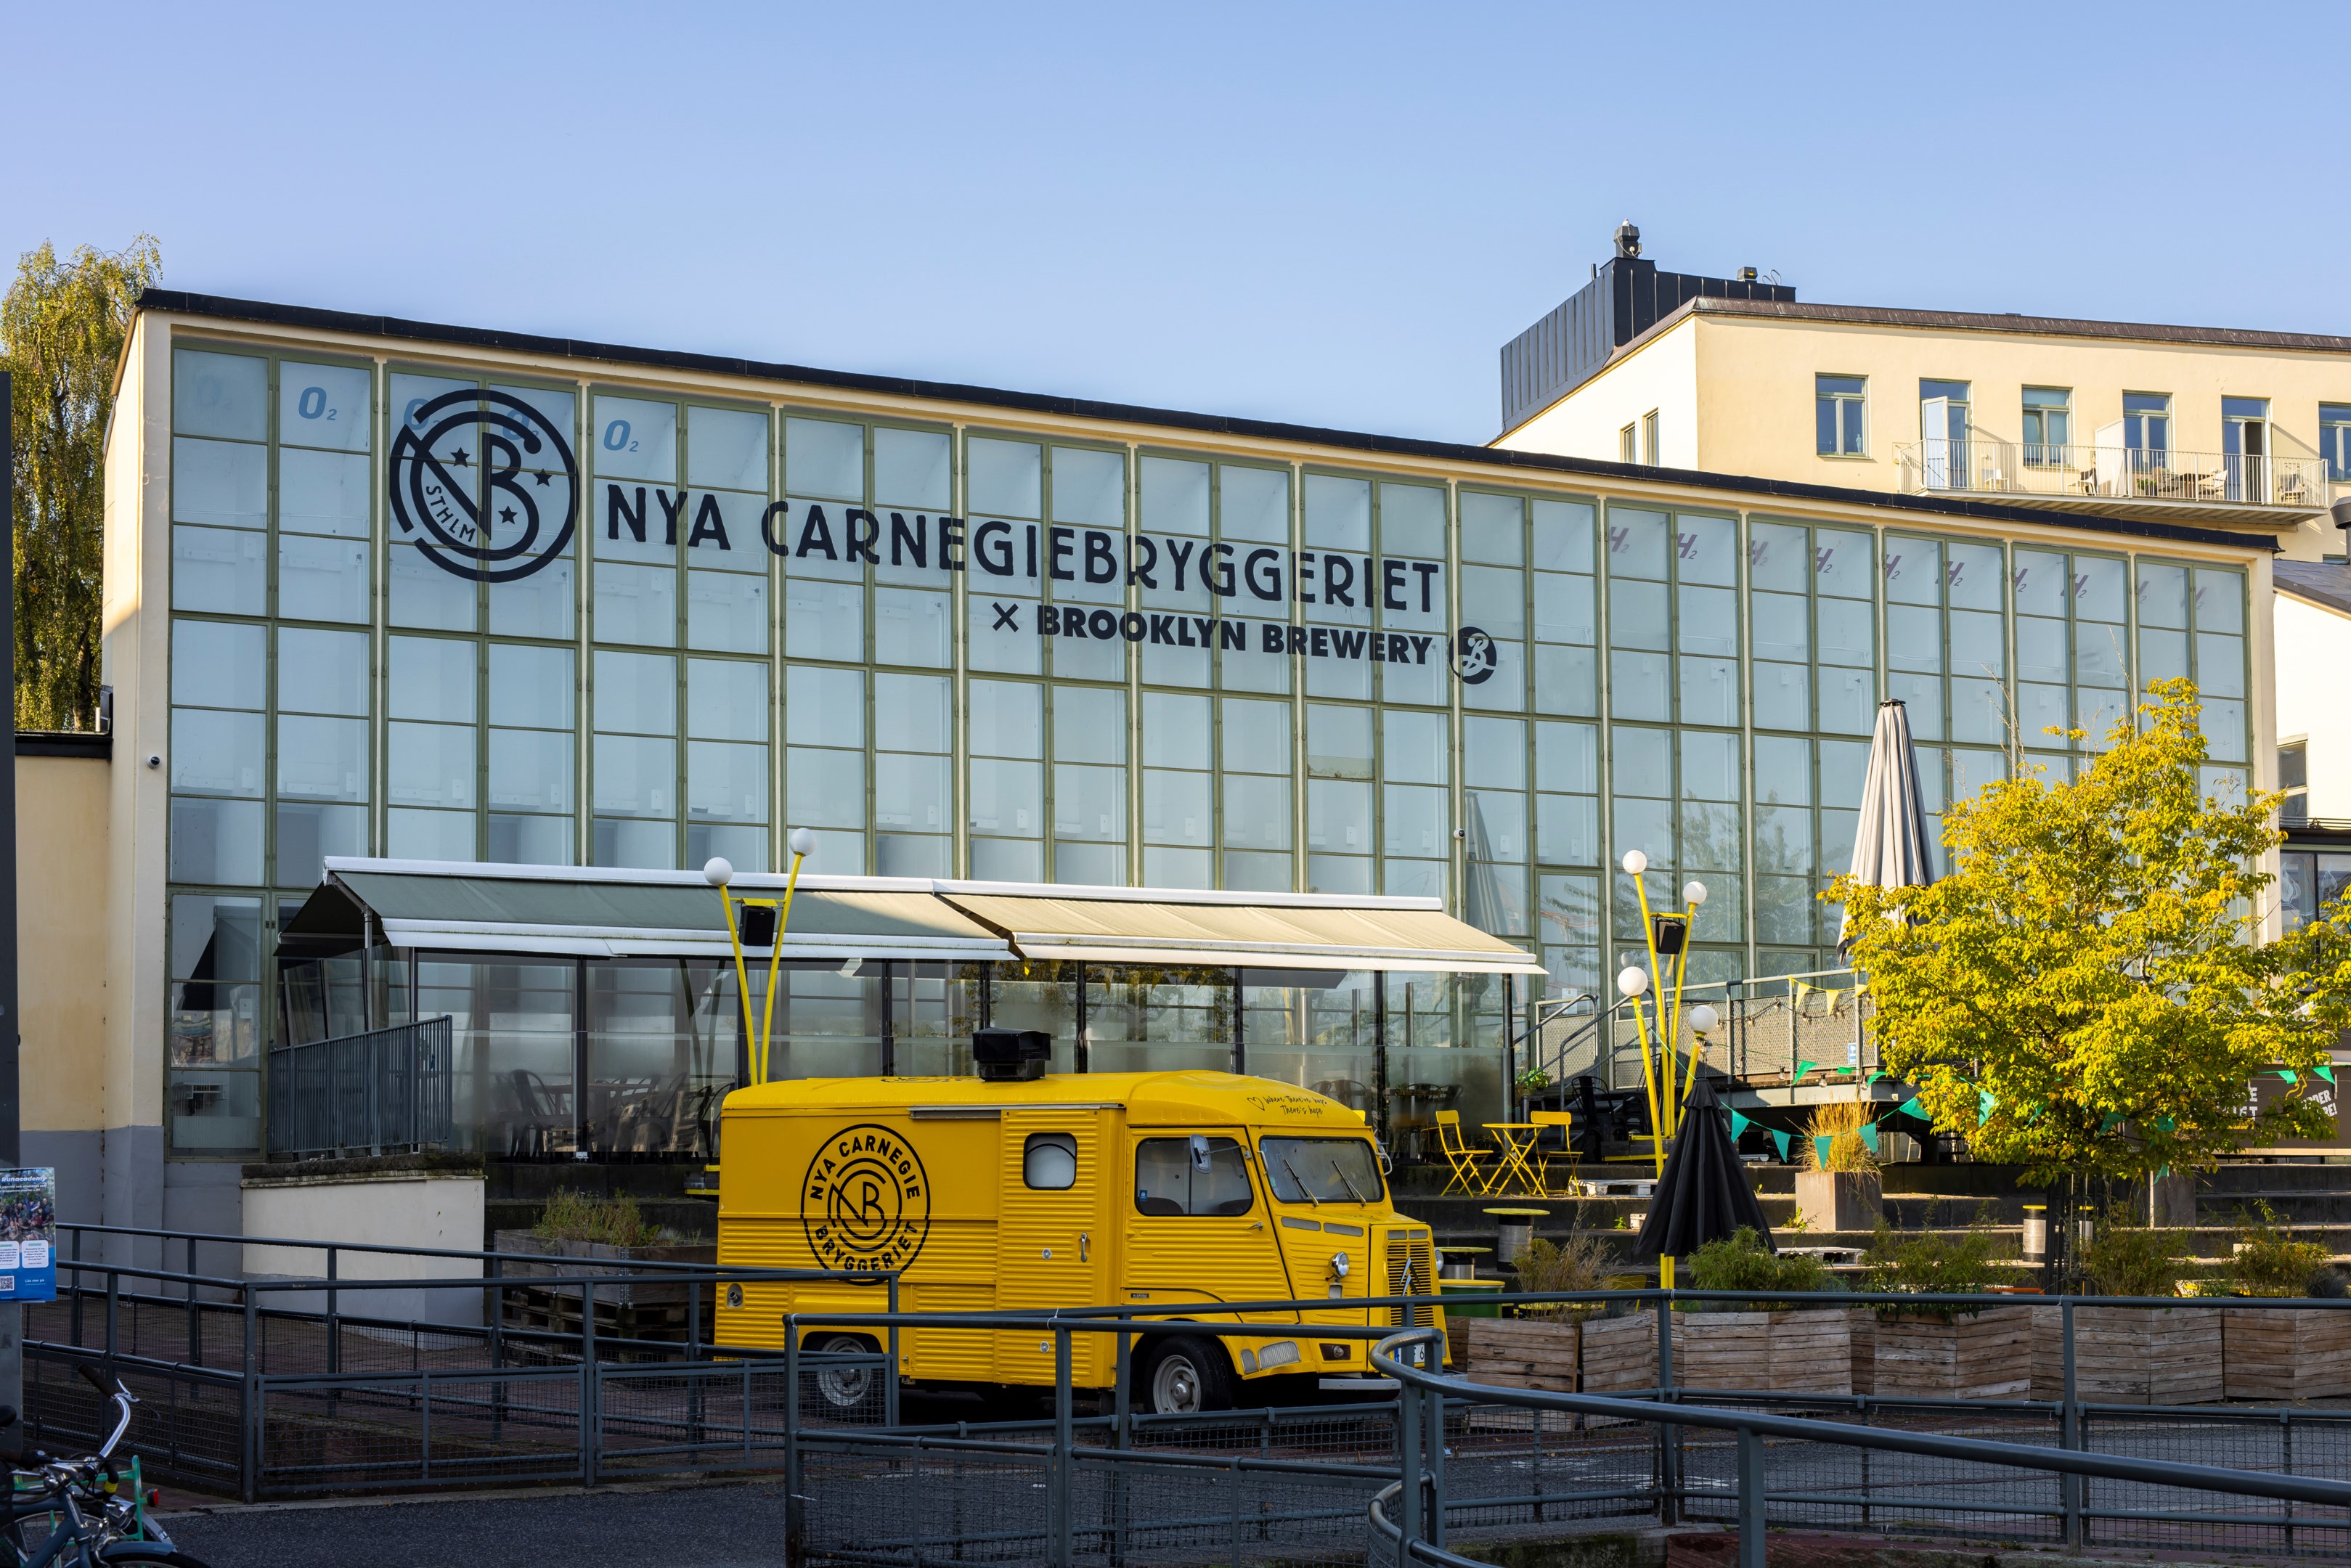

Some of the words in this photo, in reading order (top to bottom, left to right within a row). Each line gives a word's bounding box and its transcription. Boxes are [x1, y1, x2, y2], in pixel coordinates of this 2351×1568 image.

[425, 485, 476, 543] STHLM
[607, 483, 731, 551] NYA
[761, 500, 1439, 613] CARNEGIEBRYGGERIET
[1037, 605, 1247, 652] BROOKLYN
[1263, 624, 1433, 666] BREWERY
[810, 1158, 836, 1200] NYA
[839, 1135, 920, 1199] CARNEGIE
[815, 1220, 918, 1271] BRYGGERIET
